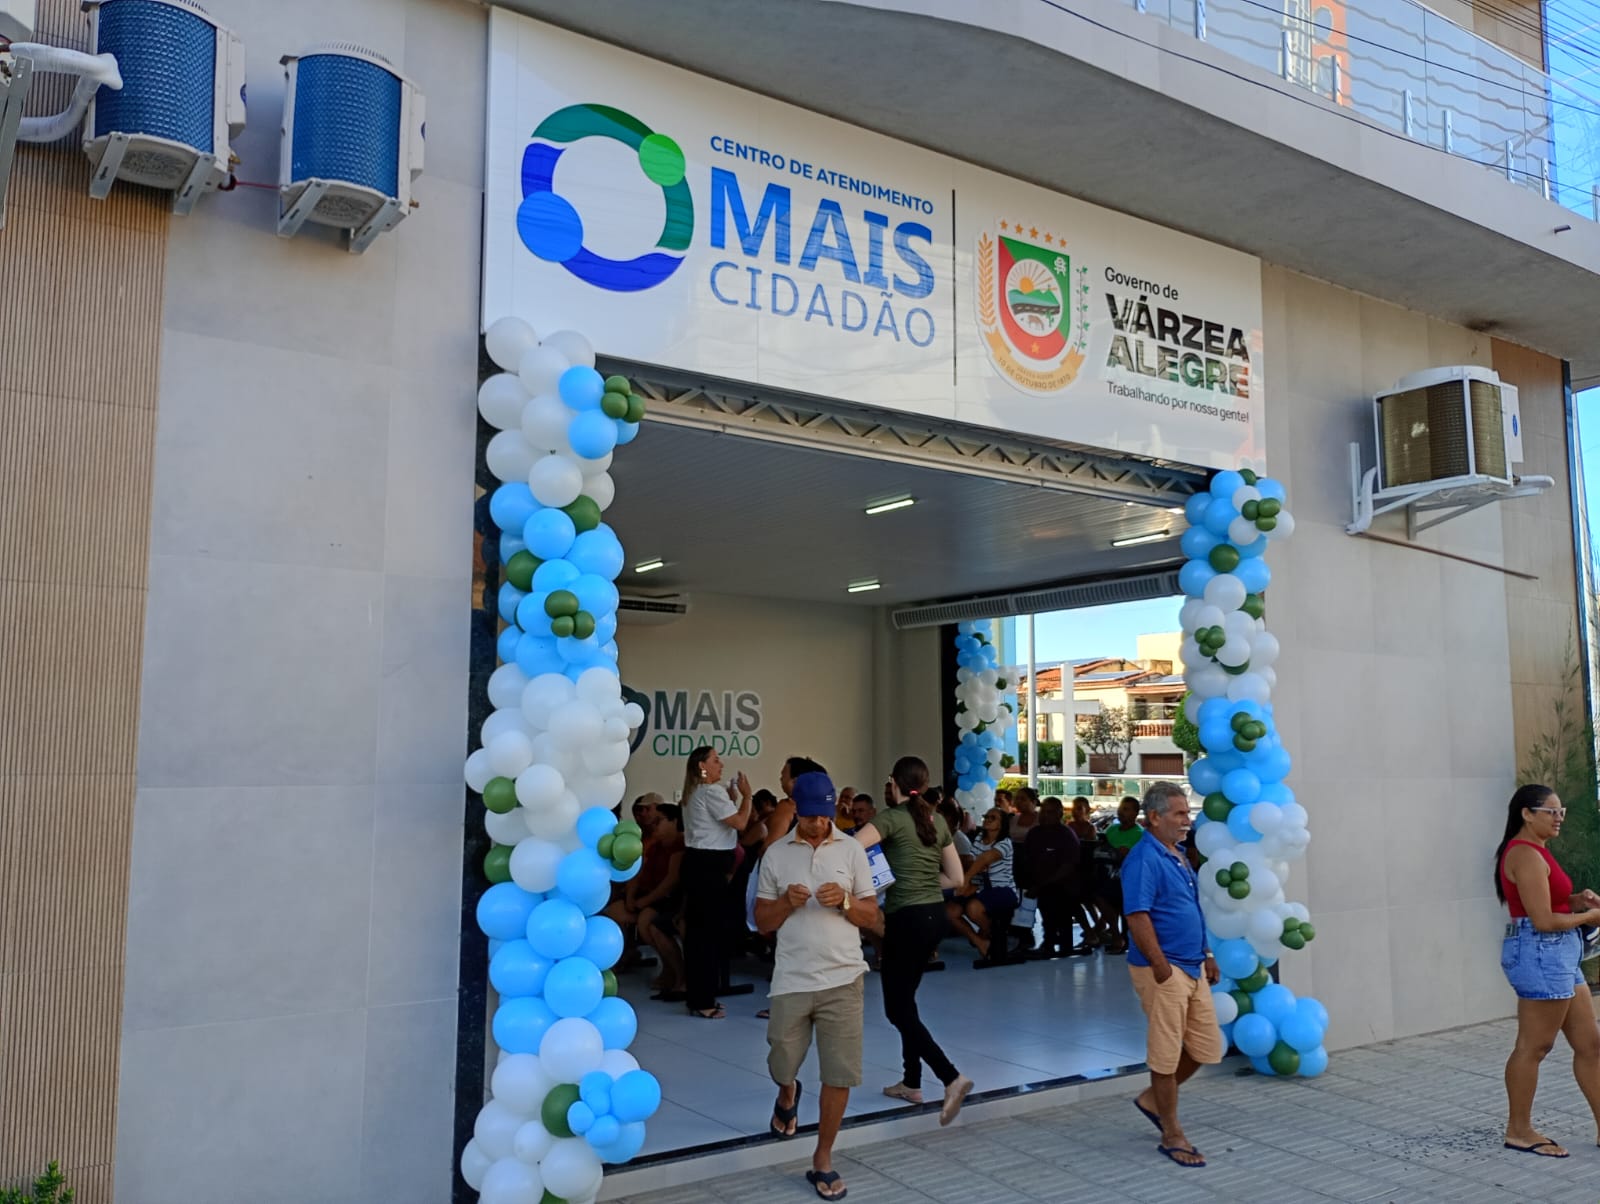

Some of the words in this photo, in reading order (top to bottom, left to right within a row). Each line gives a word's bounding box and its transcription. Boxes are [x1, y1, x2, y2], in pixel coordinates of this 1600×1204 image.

[710, 136, 785, 170] CENTRO
[790, 159, 813, 179] DE
[816, 168, 934, 215] ATENDIMENTO
[710, 166, 935, 299] MAIS
[709, 261, 935, 347] CIDADÃO
[1104, 266, 1160, 294] Governo
[1162, 284, 1179, 300] de
[1105, 292, 1250, 362] VÁRZEA
[1105, 334, 1249, 399] ALEGRE
[1107, 381, 1170, 406] Trabalhando
[1171, 397, 1188, 412] por
[1189, 401, 1218, 417] nossa
[1219, 406, 1249, 423] gente!
[654, 691, 760, 731] MAIS
